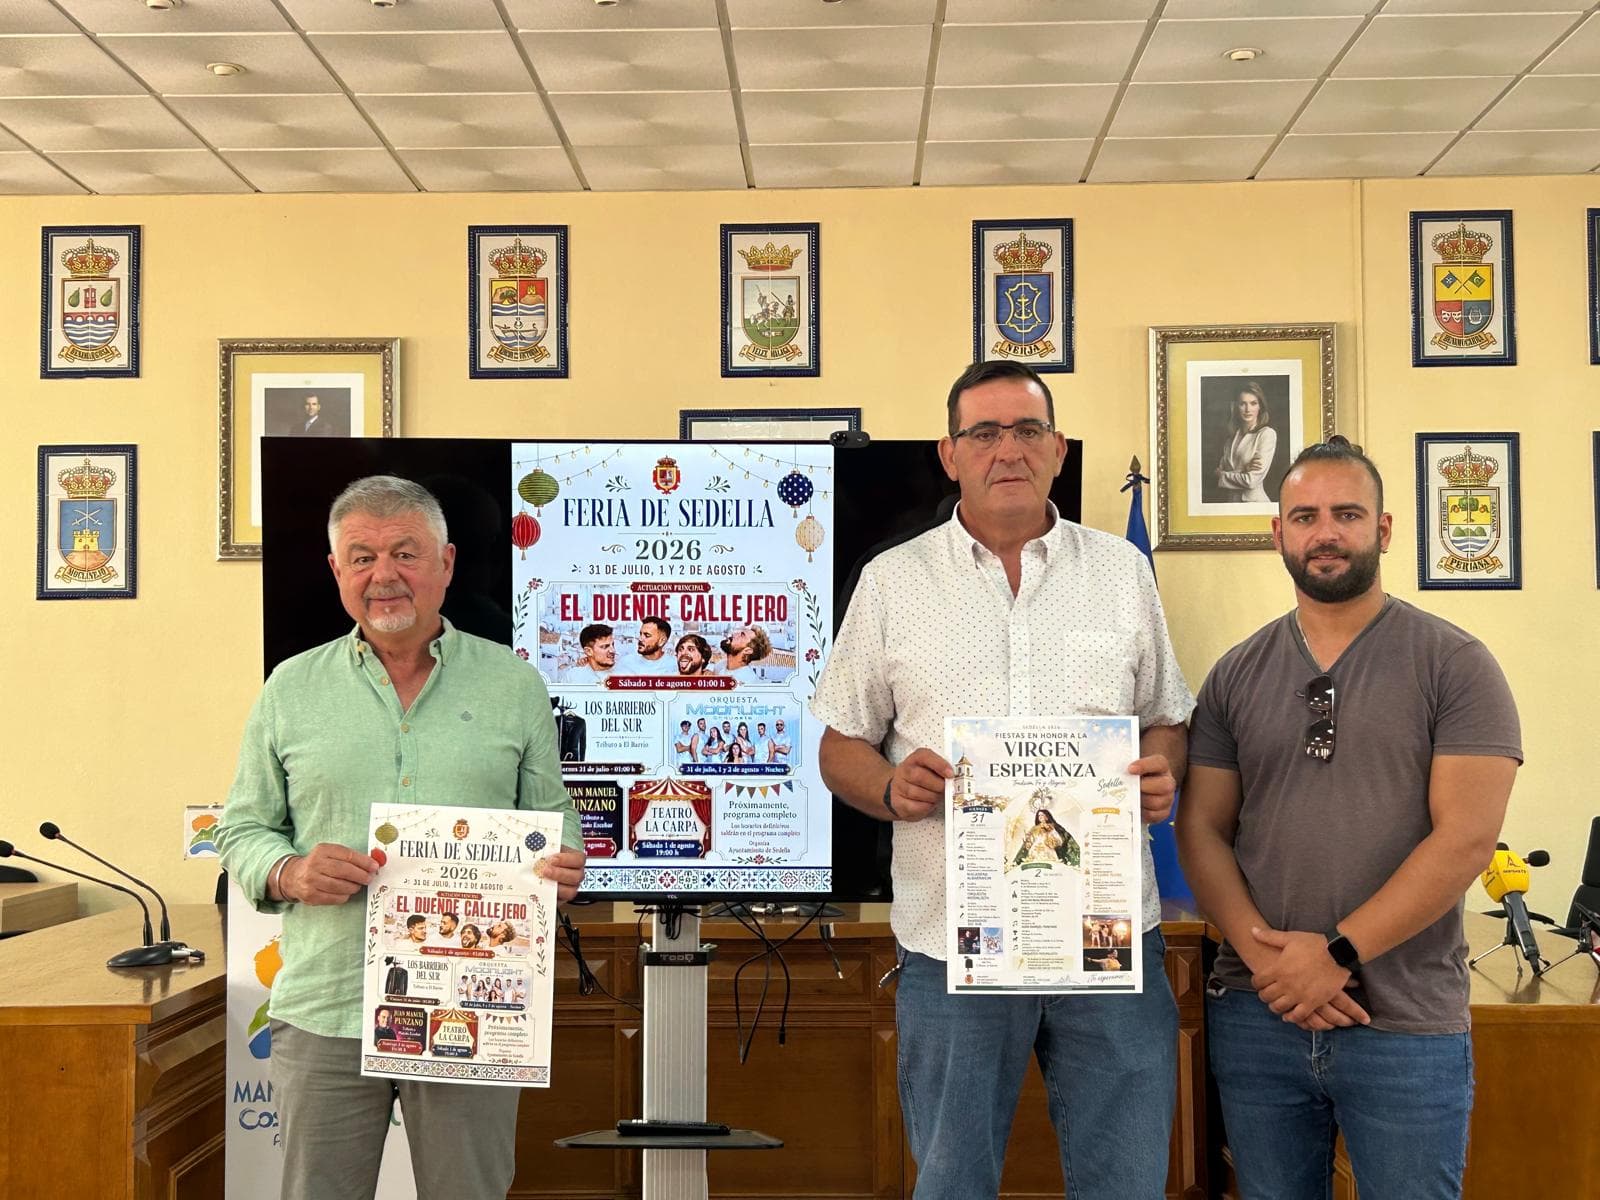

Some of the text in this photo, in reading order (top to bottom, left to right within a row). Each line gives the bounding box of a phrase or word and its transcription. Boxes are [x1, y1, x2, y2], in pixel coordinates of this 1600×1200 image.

[563, 498, 775, 528] FERIA DE SEDELLA
[635, 539, 701, 560] 2026
[589, 564, 746, 577] 31 DE JULIO, 1 Y 2 DE AGOSTO
[1450, 558, 1490, 572] PERIANA
[637, 583, 705, 592] ACTUACIÓN PRINCIPAL
[560, 594, 787, 626] EL DUENDE CALLEJERO
[618, 679, 647, 687] Sábado
[666, 681, 692, 690] agosto
[585, 701, 656, 715] LOS BARRIEROS
[601, 718, 643, 732] DEL SUR
[1005, 741, 1080, 757] VIRGEN
[989, 763, 1097, 778] ESPERANZA
[1097, 777, 1123, 792] Sedella
[568, 787, 618, 797] UAN MANUEL
[572, 799, 616, 811] UNZANO
[729, 801, 789, 809] Próximamente,
[652, 807, 692, 818] TEATRO
[723, 811, 797, 820] programa completo
[970, 812, 985, 823] 31
[645, 821, 698, 832] LA CARPA
[399, 840, 522, 864] FERIA DE SEDELLA
[440, 866, 478, 880] 2026
[1034, 868, 1042, 878] 2
[431, 880, 451, 889] JULIO,
[480, 883, 504, 891] AGOSTO
[396, 895, 527, 921] EL DUENDE CALLEJERO
[407, 960, 418, 969] LOS
[416, 970, 427, 980] DEL
[394, 1016, 424, 1026] PUNZANO
[443, 1025, 467, 1034] TEATRO
[439, 1033, 470, 1043] LA CARPA
